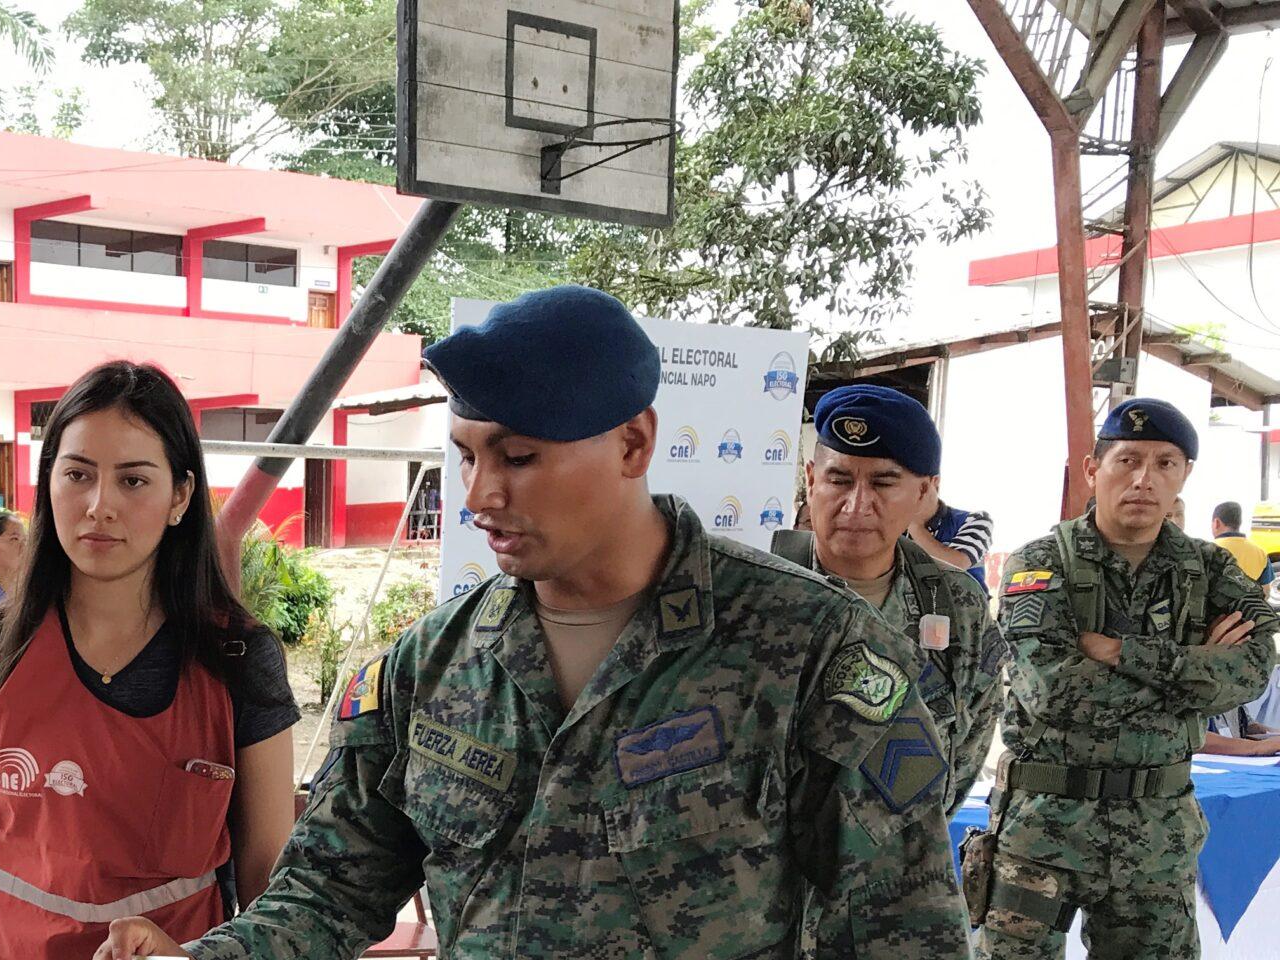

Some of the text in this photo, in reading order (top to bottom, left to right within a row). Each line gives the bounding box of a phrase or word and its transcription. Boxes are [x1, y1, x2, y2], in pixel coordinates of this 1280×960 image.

[672, 348, 738, 369] ELECTORAL
[660, 371, 717, 388] NCIAL NAPO
[413, 722, 505, 781] FUERZA AEREA
